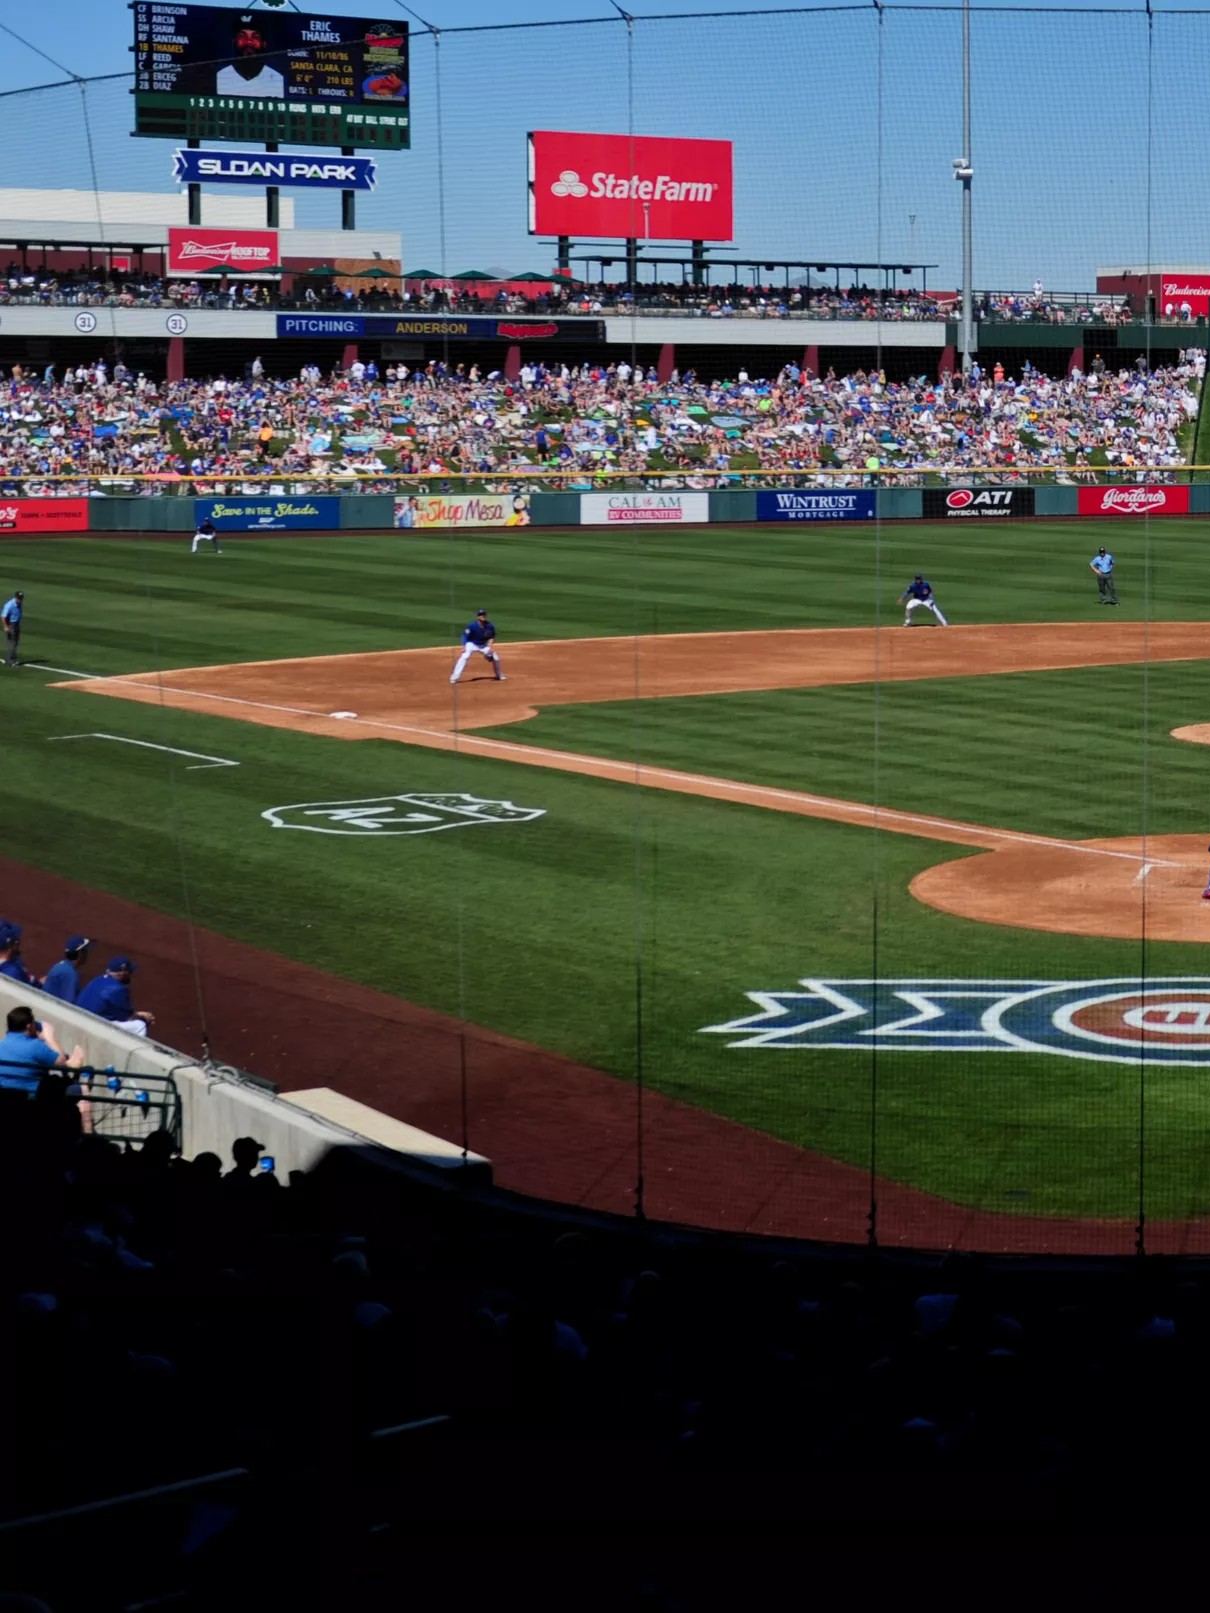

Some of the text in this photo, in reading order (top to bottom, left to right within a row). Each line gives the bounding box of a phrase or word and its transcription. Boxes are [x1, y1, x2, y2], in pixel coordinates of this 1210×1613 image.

[152, 5, 188, 15] BRINSON
[138, 14, 176, 24] SS ARCIA
[138, 24, 176, 34] DH SHAW
[310, 20, 332, 32] ERIC
[152, 34, 190, 44] SANTANA
[300, 30, 341, 43] THAMES
[152, 44, 184, 53] THAMES
[138, 52, 172, 62] LF REED
[138, 62, 144, 70] C
[290, 61, 314, 70] SANTA
[343, 65, 354, 74] CA
[152, 72, 177, 82] ERCEG
[341, 77, 354, 86] LBS
[152, 82, 172, 90] DIAZ
[190, 98, 195, 107] 1
[199, 98, 205, 108] 2
[208, 98, 214, 108] 3
[219, 100, 225, 108] 4
[228, 100, 234, 109] 5
[238, 100, 244, 110] 6
[248, 100, 254, 110] 7
[258, 102, 264, 111] 8
[268, 102, 274, 111] 9
[277, 103, 286, 112] 10
[198, 159, 356, 180] SLOAN PARK
[79, 317, 92, 328] 31
[171, 318, 184, 330] 31
[396, 322, 468, 334] ANDERSON
[608, 496, 682, 508] CAL AM
[972, 491, 1013, 504] ATI
[1101, 487, 1166, 511] Giordano's
[211, 504, 243, 518] Save
[245, 506, 256, 516] IN
[256, 506, 272, 516] THE
[427, 499, 506, 524] Shop Mesa
[622, 510, 682, 519] COMMUNITIES
